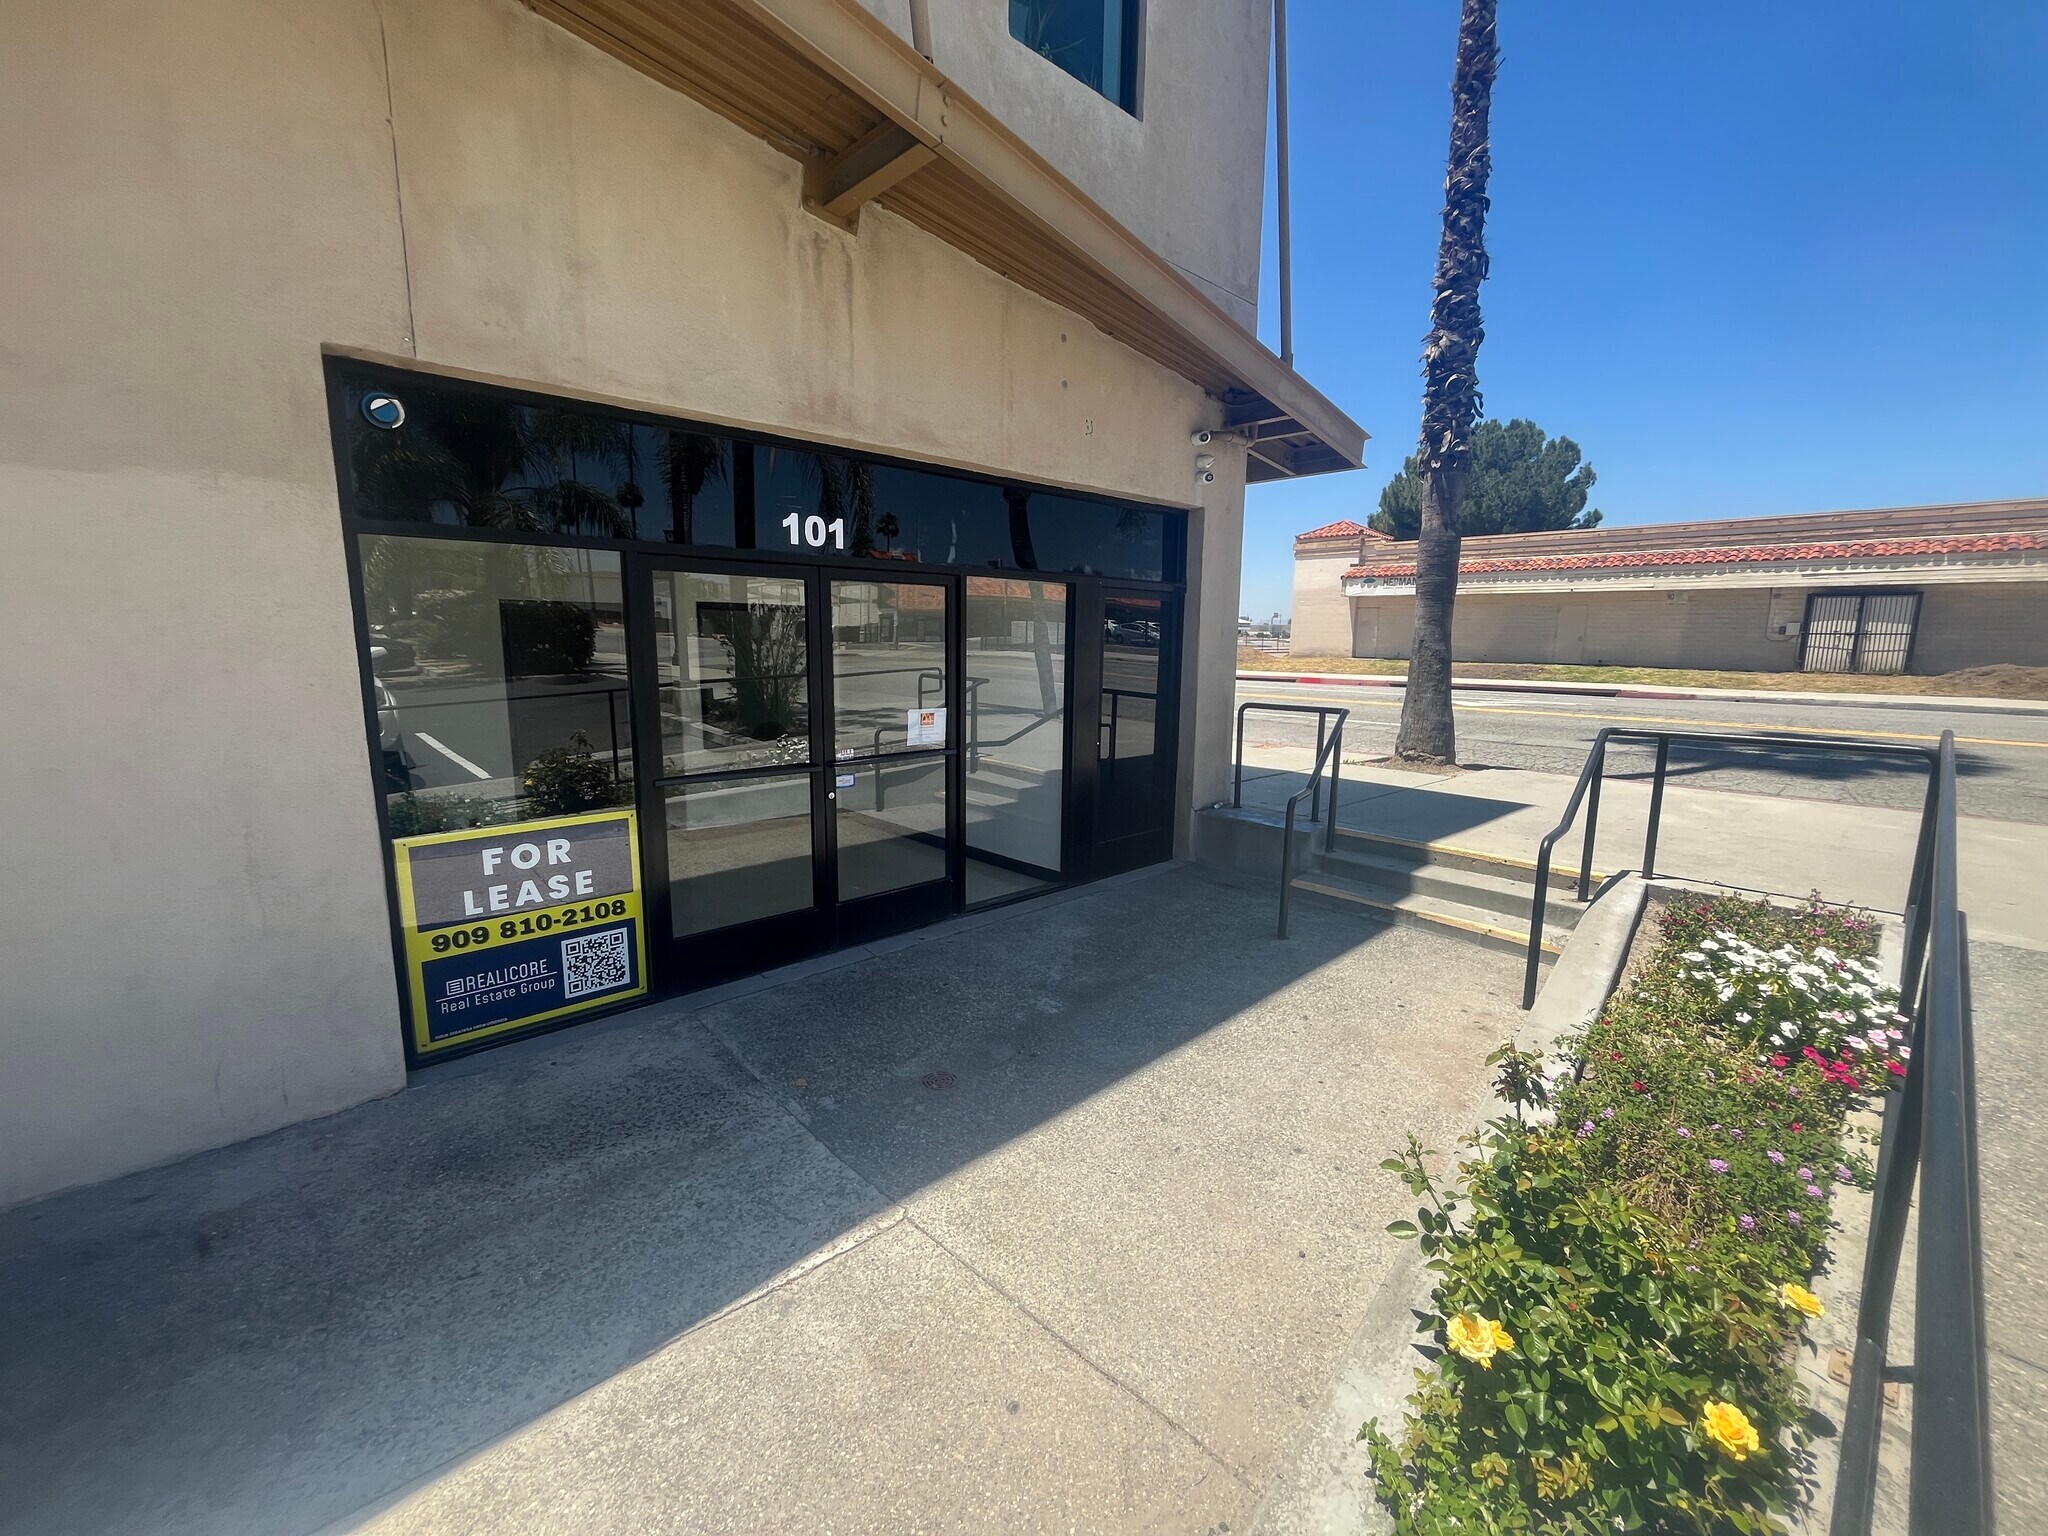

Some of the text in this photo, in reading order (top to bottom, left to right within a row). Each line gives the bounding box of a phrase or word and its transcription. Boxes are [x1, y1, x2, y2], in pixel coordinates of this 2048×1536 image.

[782, 512, 844, 549] 101
[482, 838, 571, 876] FOR
[463, 870, 594, 916] LEASE
[431, 899, 626, 952] 909 810-2108
[466, 959, 548, 991] REALICORE
[441, 978, 555, 1014] Real Estate Group
